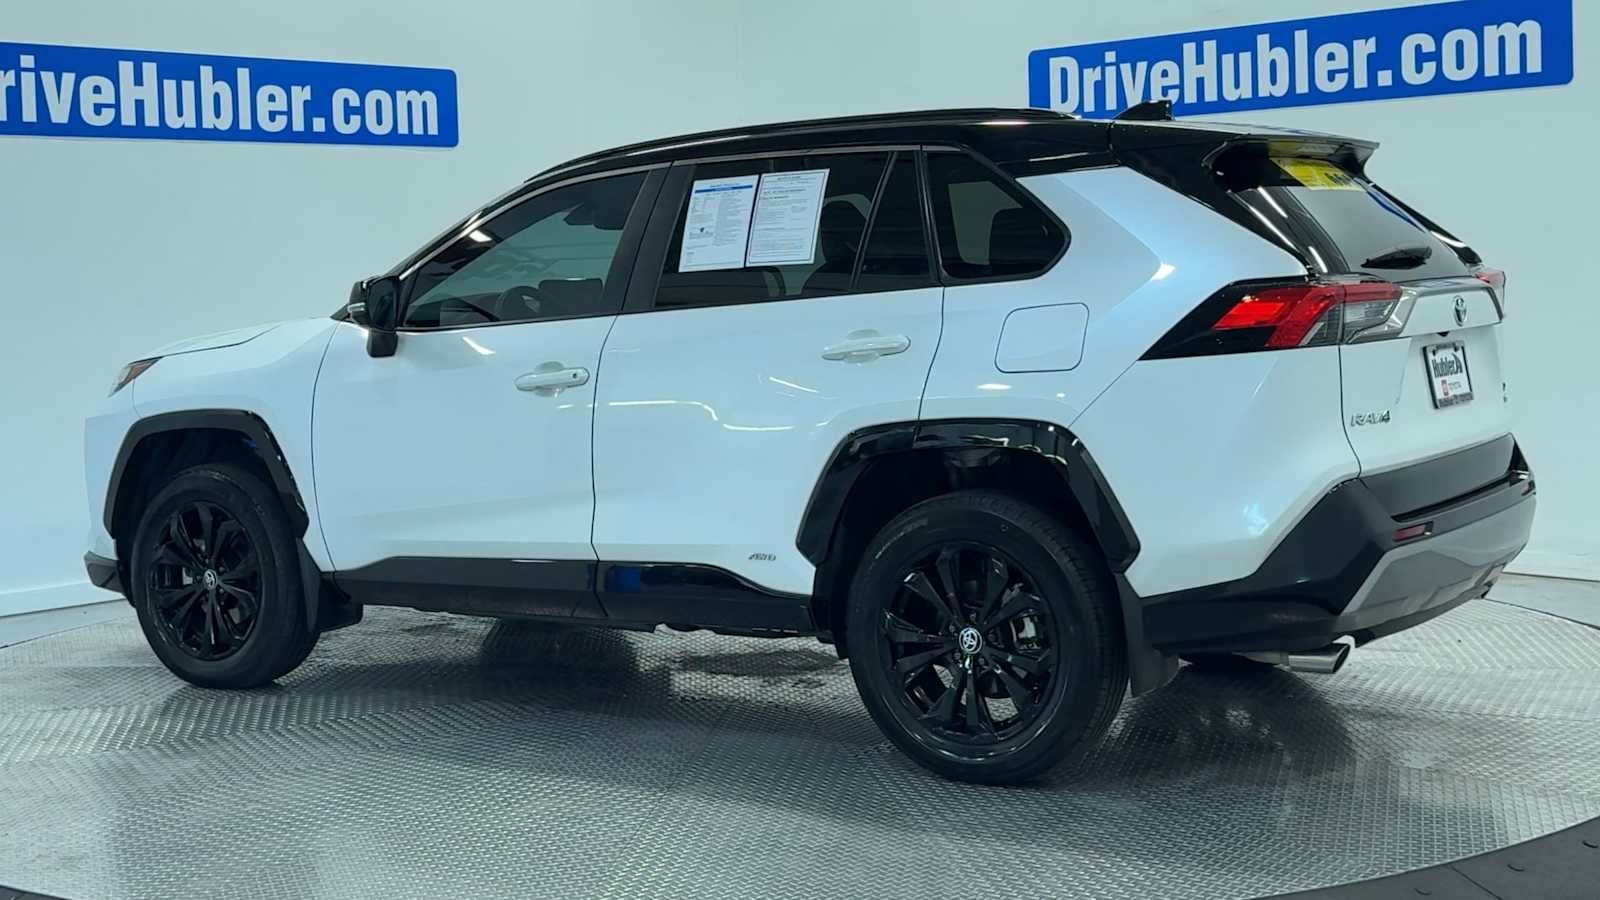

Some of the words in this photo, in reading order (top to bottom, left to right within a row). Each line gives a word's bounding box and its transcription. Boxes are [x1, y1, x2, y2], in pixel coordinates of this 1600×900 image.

[1049, 18, 1542, 114] DriveHubler.com
[1431, 356, 1456, 378] Hubler
[1350, 410, 1390, 427] RAV4
